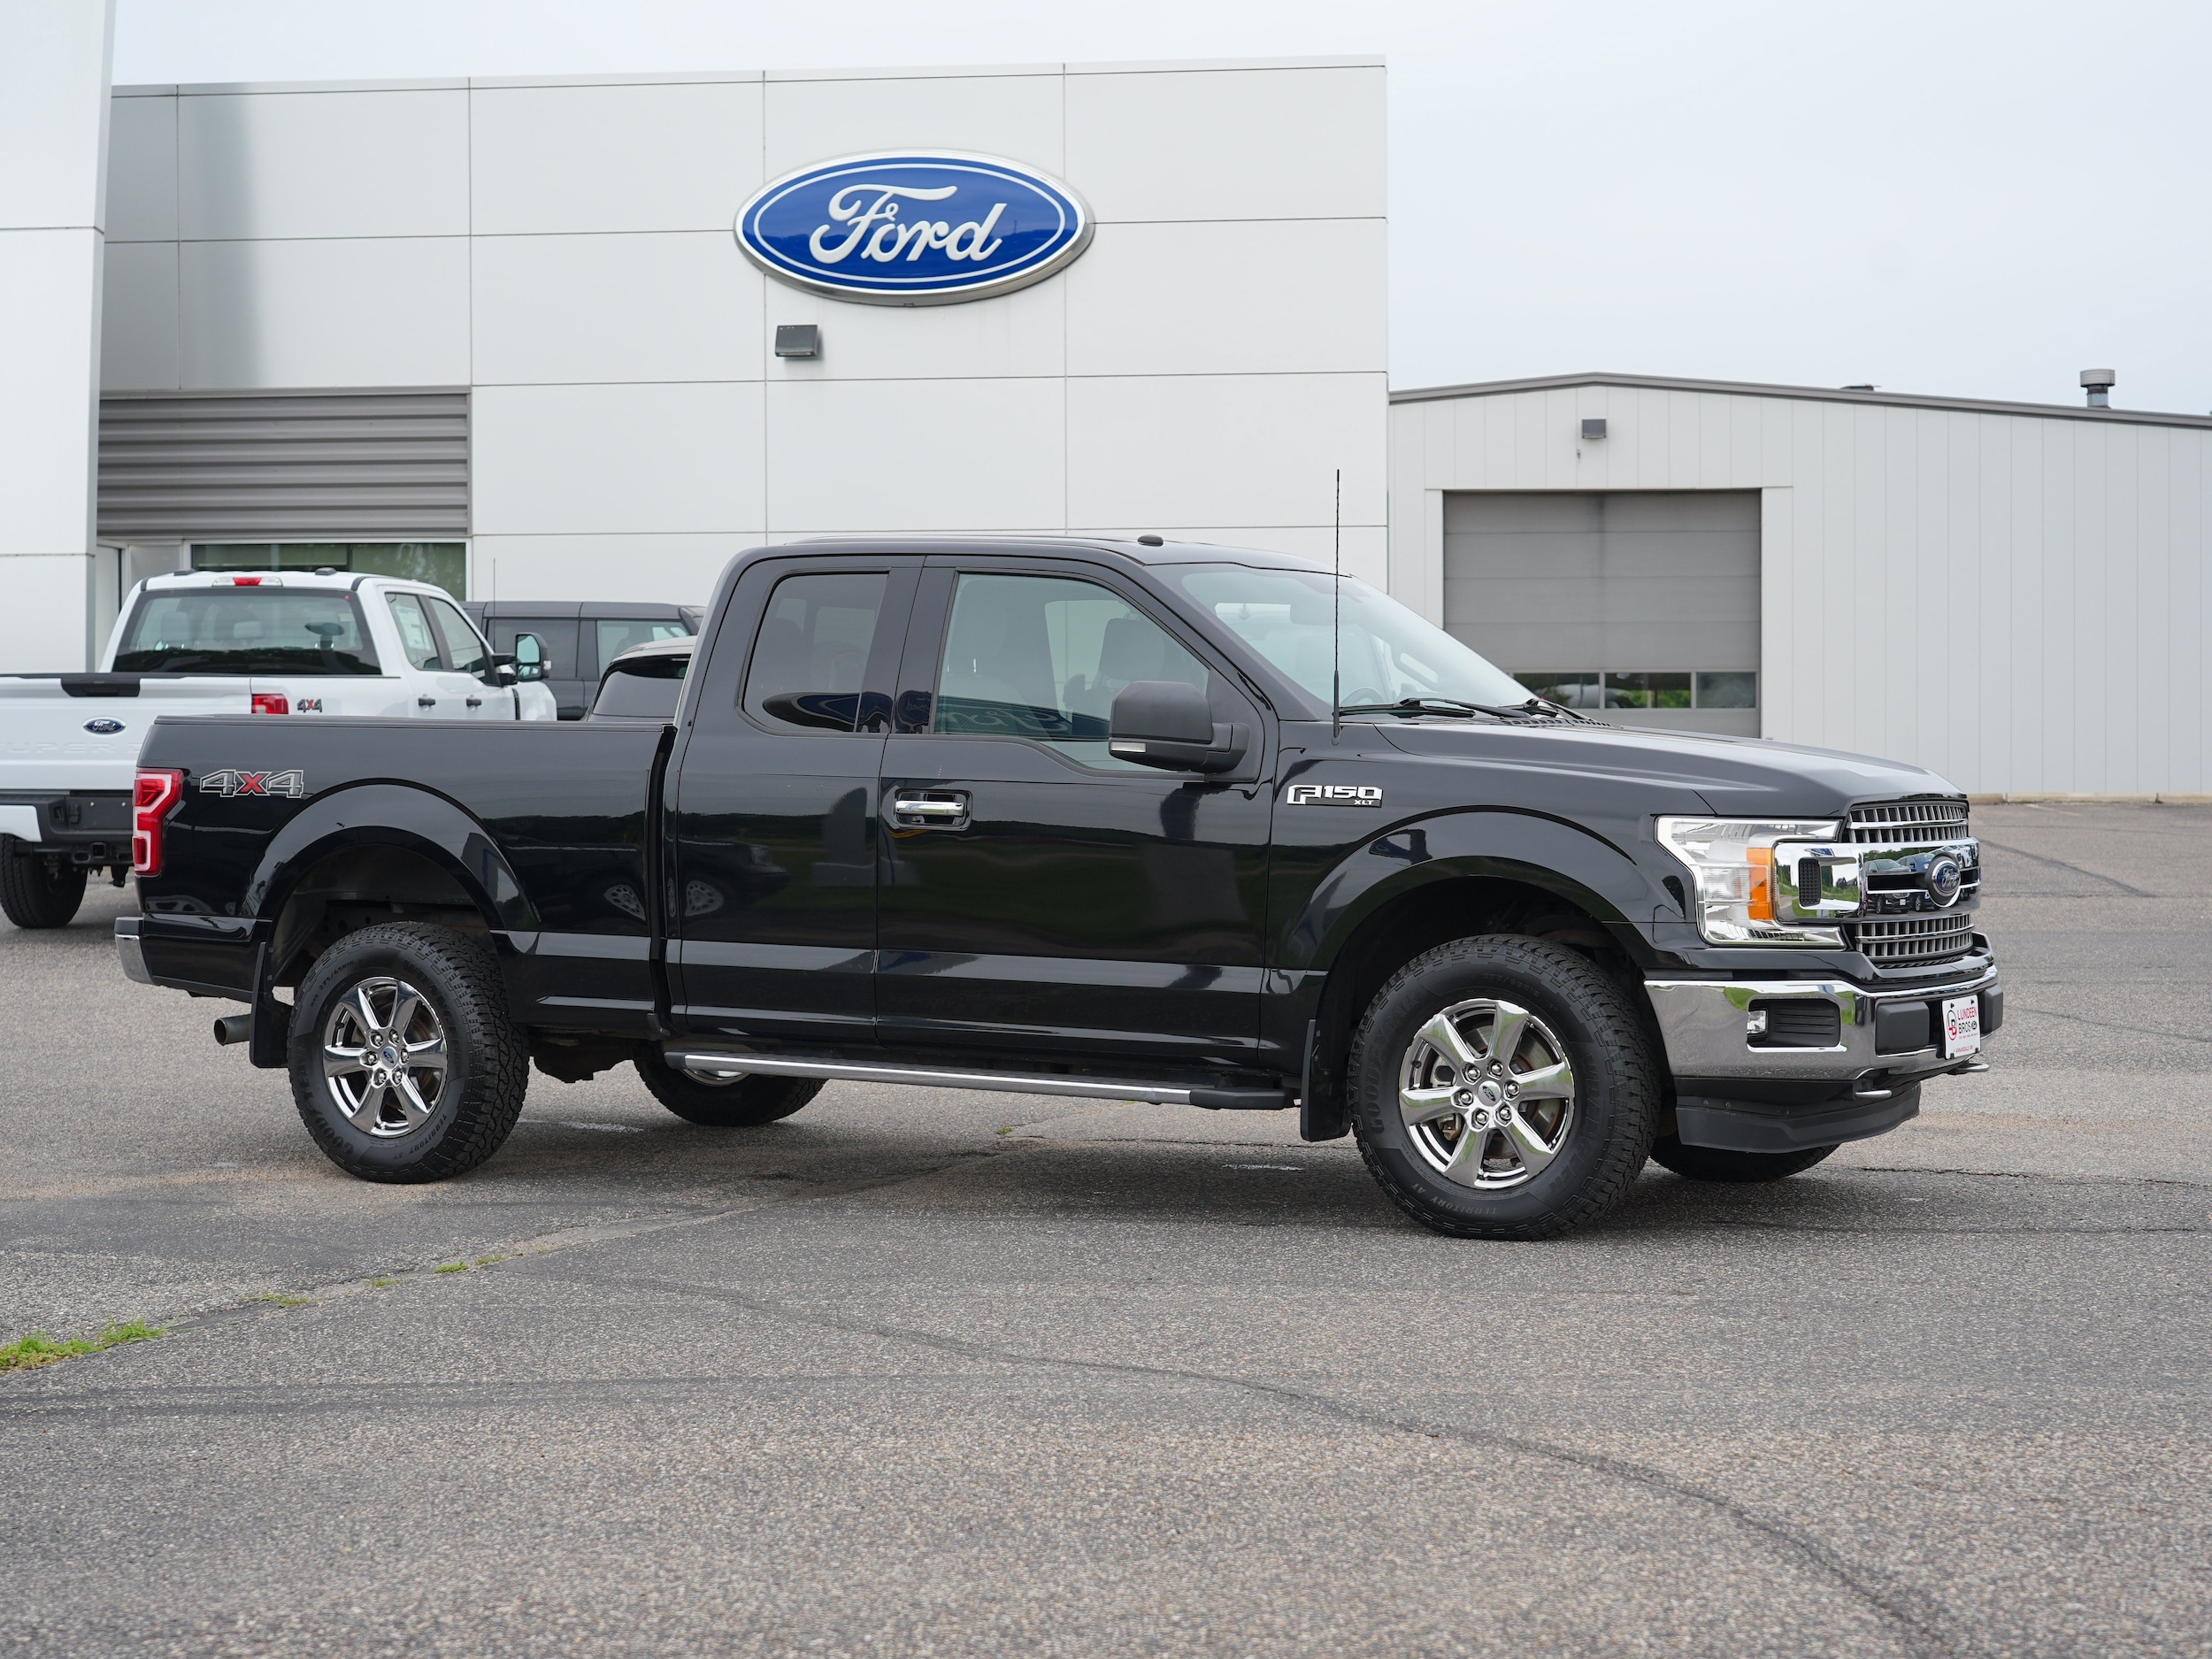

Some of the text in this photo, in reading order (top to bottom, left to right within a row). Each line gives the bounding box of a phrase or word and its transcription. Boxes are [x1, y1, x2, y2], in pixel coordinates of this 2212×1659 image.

[809, 183, 1007, 264] Ford
[92, 719, 116, 732] Ford
[0, 741, 116, 753] UPER
[1957, 1007, 1977, 1020] LUNDEEN
[1958, 1021, 1971, 1034] BROS
[1431, 1195, 1499, 1215] TERRITORY
